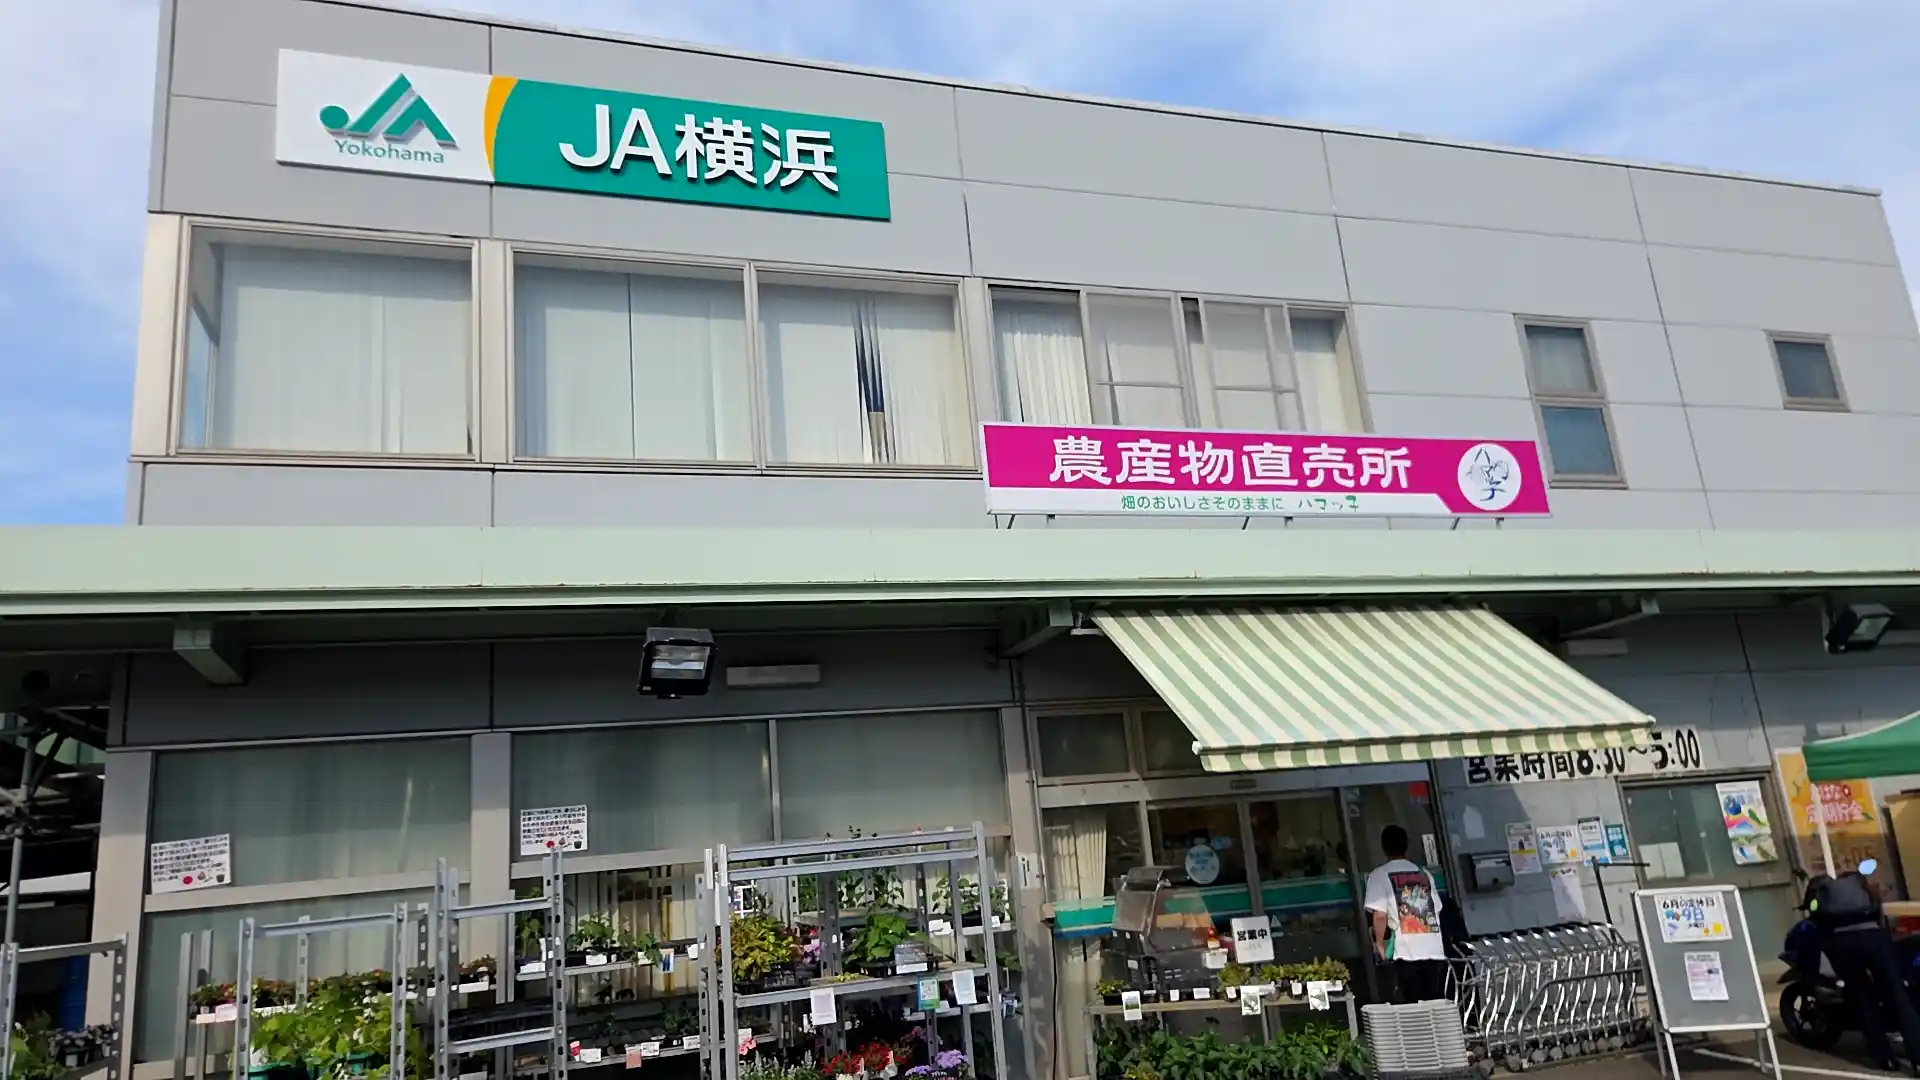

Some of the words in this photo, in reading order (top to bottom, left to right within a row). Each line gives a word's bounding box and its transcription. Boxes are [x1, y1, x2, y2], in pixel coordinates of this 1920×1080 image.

[334, 138, 445, 164] Yokohama
[559, 103, 839, 193] JA横浜
[1049, 435, 1412, 489] 農産物直売所
[1121, 495, 1284, 510] 畑のおいしさそのままに
[1237, 928, 1267, 941] 営業中
